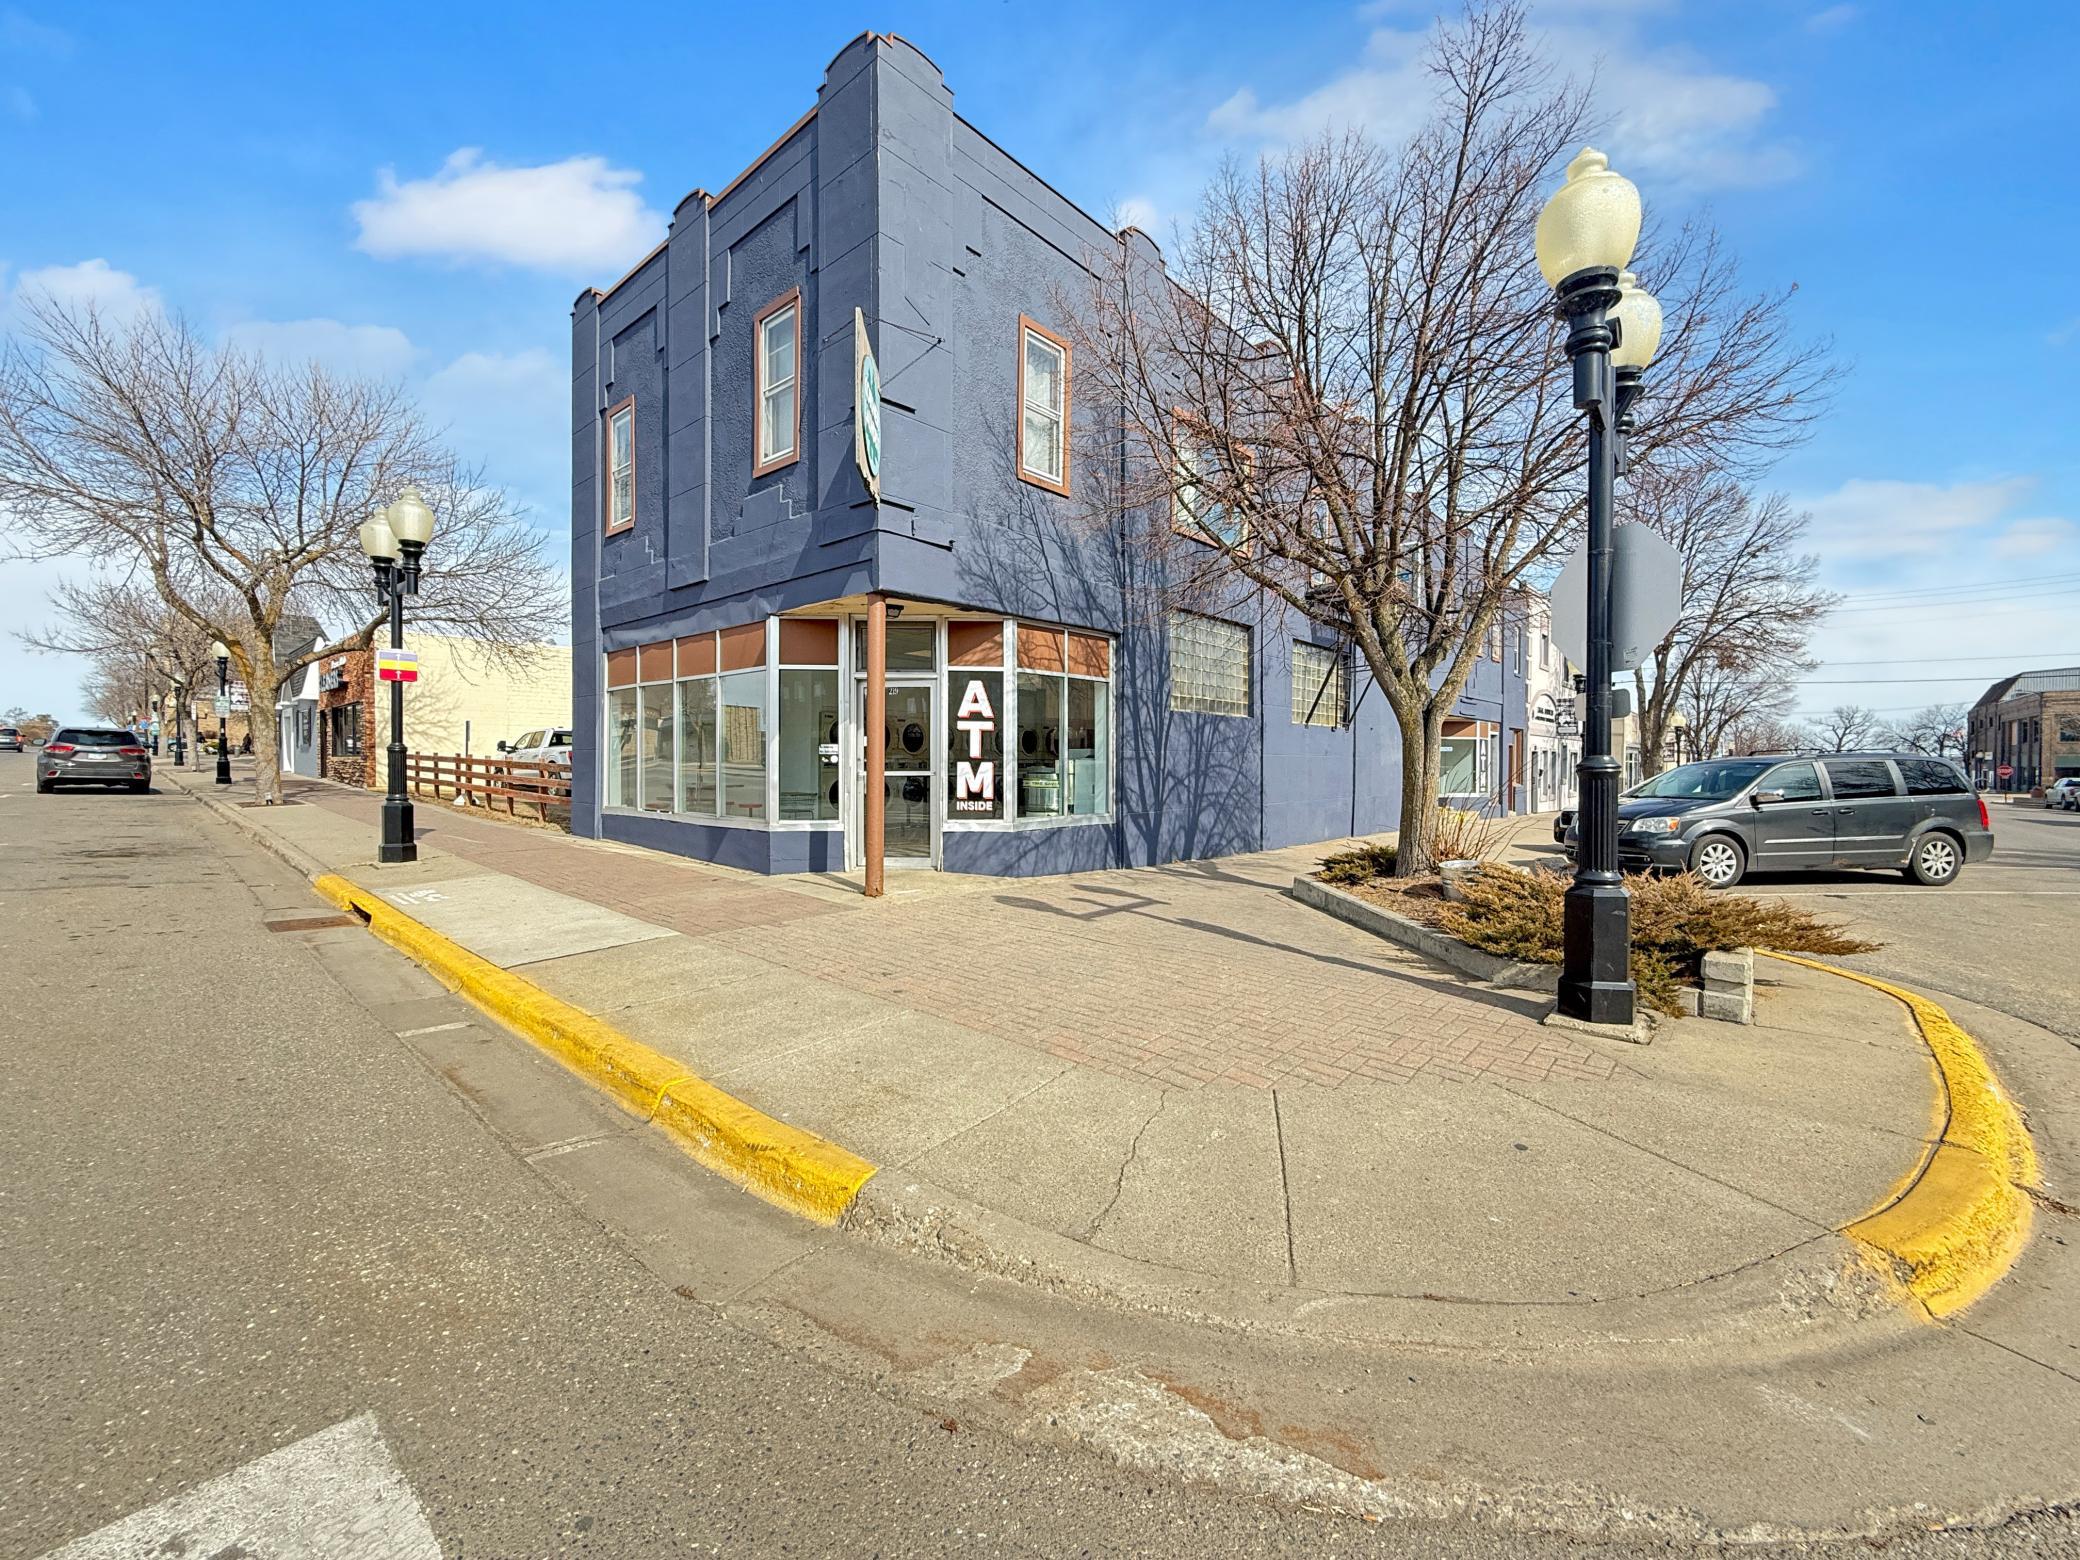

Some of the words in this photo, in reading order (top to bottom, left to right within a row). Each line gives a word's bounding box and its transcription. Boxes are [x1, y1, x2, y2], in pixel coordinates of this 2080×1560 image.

[888, 687, 899, 696] 219
[956, 680, 995, 800] ATM
[956, 801, 993, 811] INSIDE
